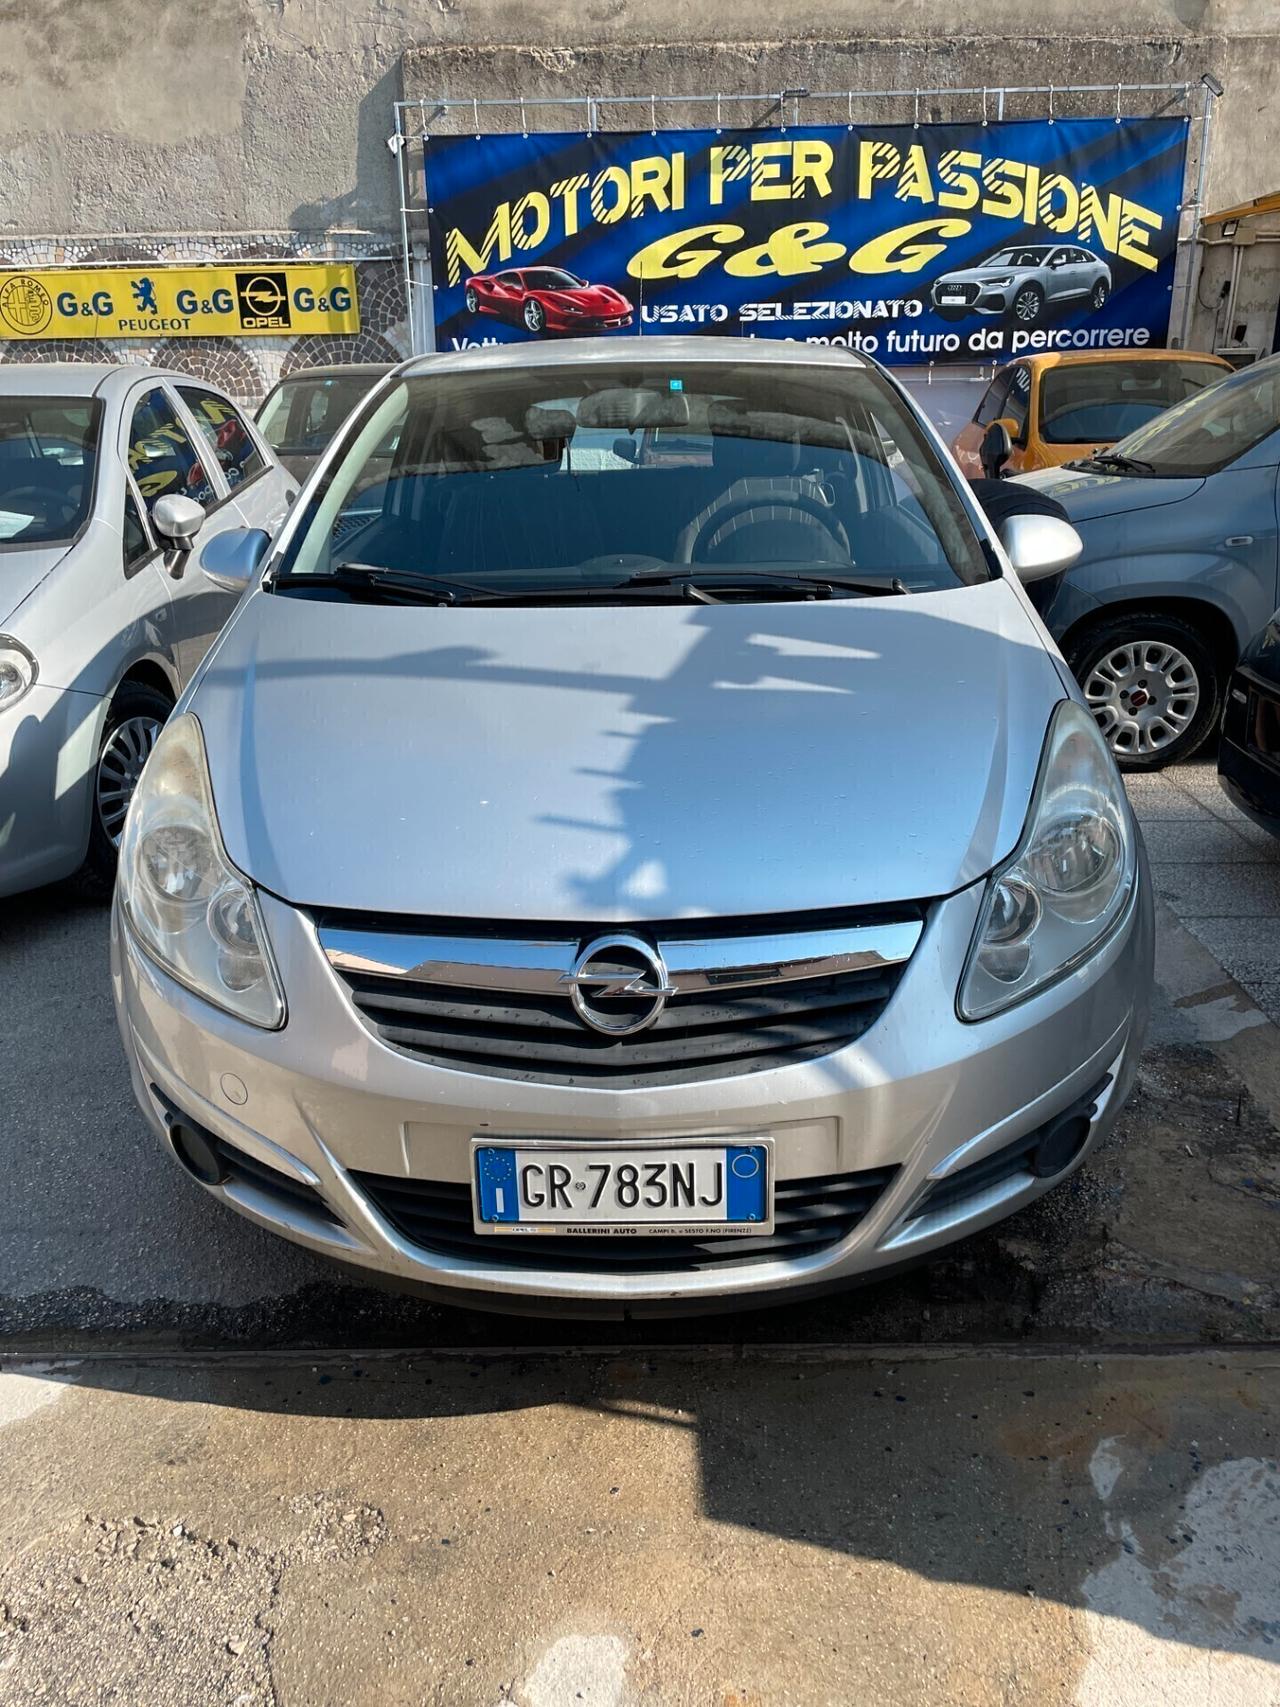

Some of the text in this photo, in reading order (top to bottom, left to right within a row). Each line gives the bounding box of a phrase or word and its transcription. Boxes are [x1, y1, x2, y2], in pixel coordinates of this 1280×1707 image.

[446, 140, 1163, 288] MOTORI PER PASSIONE
[626, 218, 972, 280] G&G
[20, 279, 49, 306] ROMEO
[57, 291, 114, 317] G&G
[176, 288, 234, 315] G&G
[294, 286, 351, 313] G&G
[119, 318, 191, 331] PEUGEOT
[242, 316, 289, 329] OPEL
[641, 299, 923, 323] USATO SELEZIONATO
[887, 329, 961, 353] futuro
[968, 328, 1003, 352] da
[1011, 326, 1150, 353] percorrere
